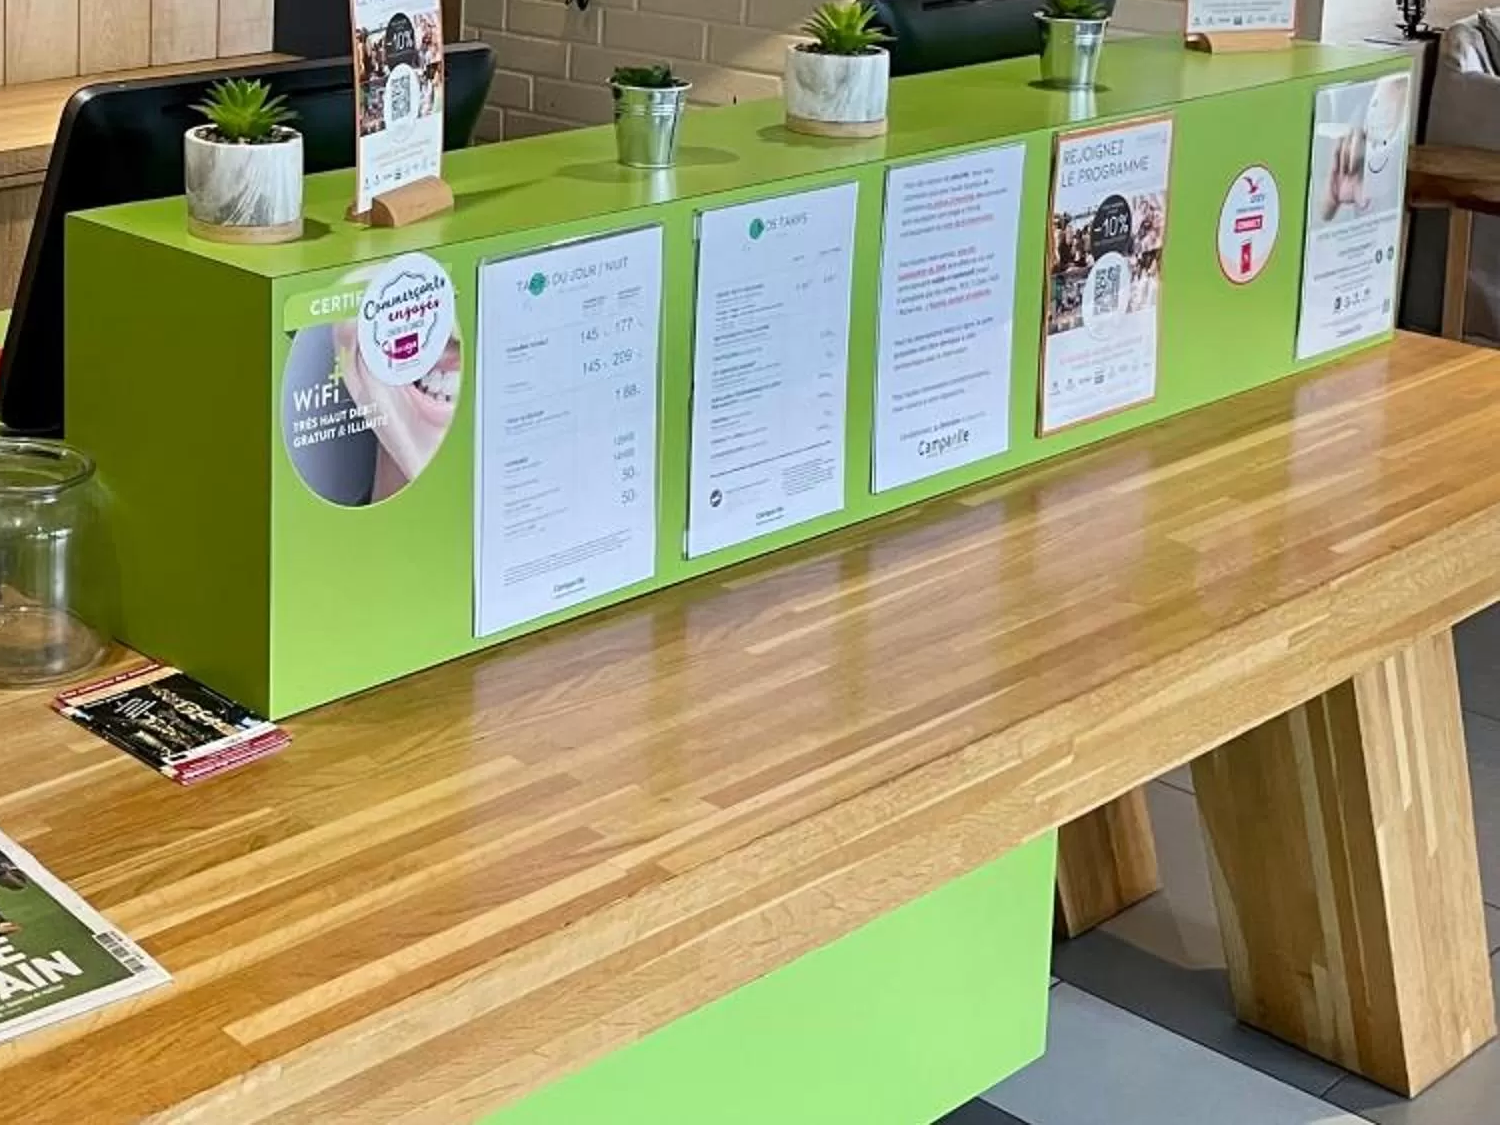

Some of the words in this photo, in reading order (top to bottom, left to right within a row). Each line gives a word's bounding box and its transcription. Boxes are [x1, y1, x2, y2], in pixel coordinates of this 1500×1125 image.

[1061, 170, 1074, 187] LE
[293, 383, 338, 412] WiFi
[293, 425, 336, 448] GRATUIT
